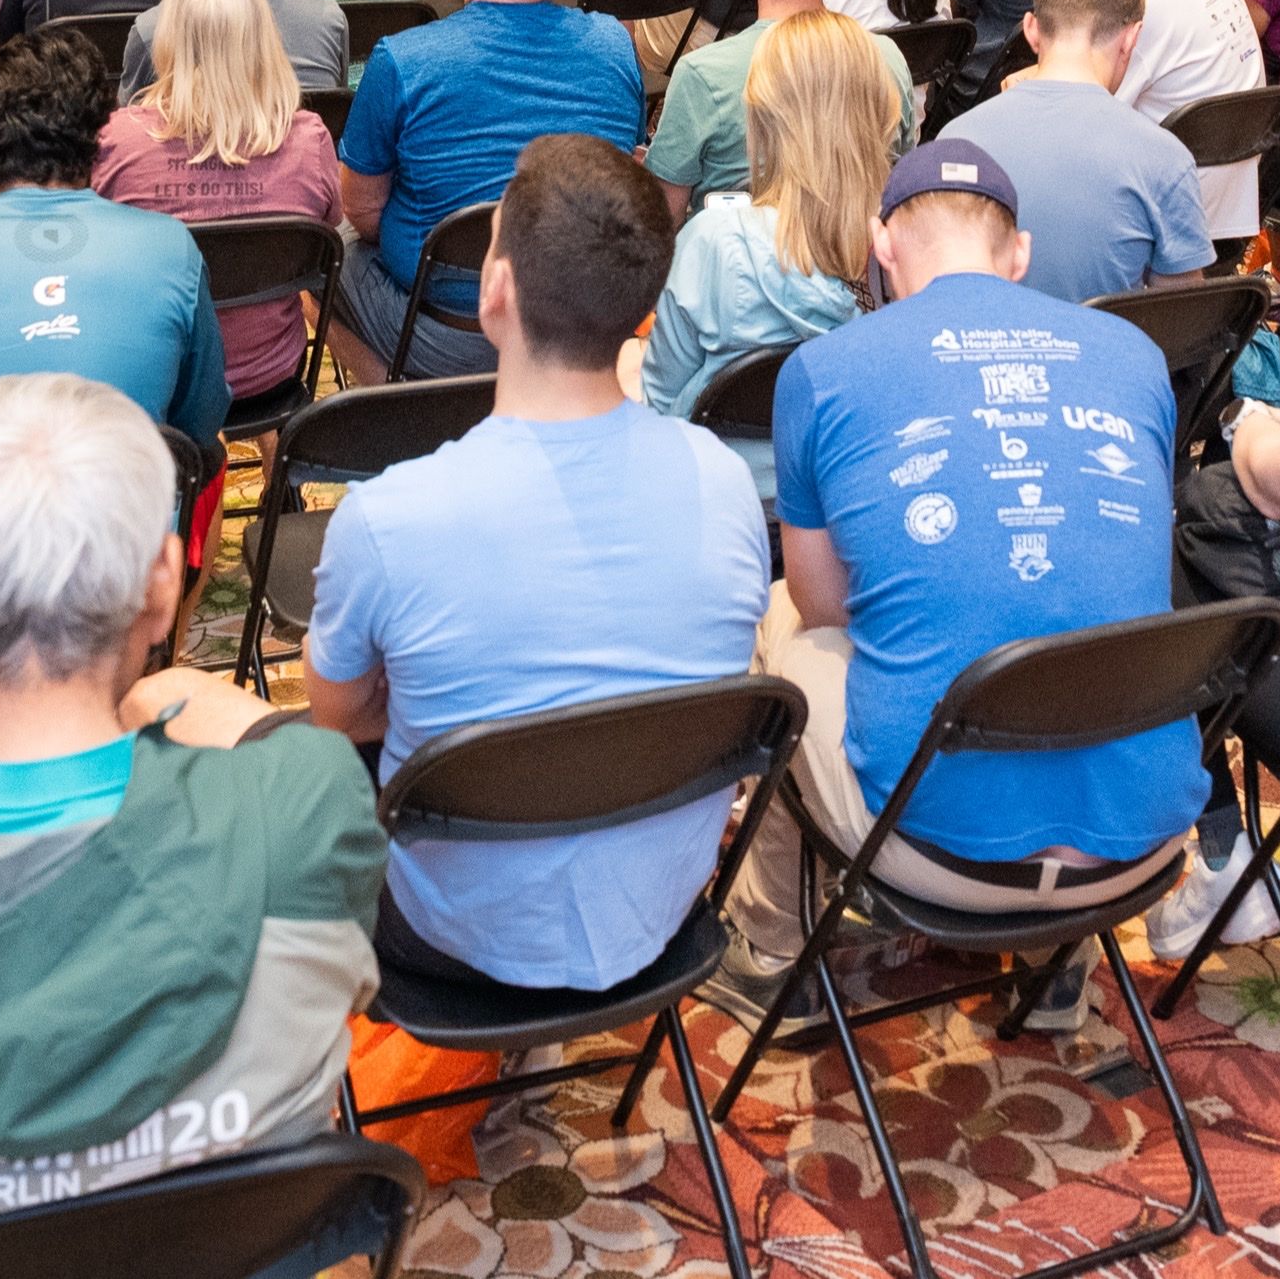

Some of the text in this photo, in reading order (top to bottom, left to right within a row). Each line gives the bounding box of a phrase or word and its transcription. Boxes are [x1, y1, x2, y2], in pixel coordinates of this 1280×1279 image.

[155, 182, 263, 197] LET'S DO THIS!
[960, 328, 1052, 340] Lehigh Valley
[938, 354, 961, 363] Your
[963, 354, 993, 362] health
[994, 354, 1035, 362] deserves
[982, 460, 1049, 472] broadway
[997, 504, 1065, 518] pennsylvania
[1014, 535, 1045, 549] RUN
[168, 1089, 250, 1155] 20
